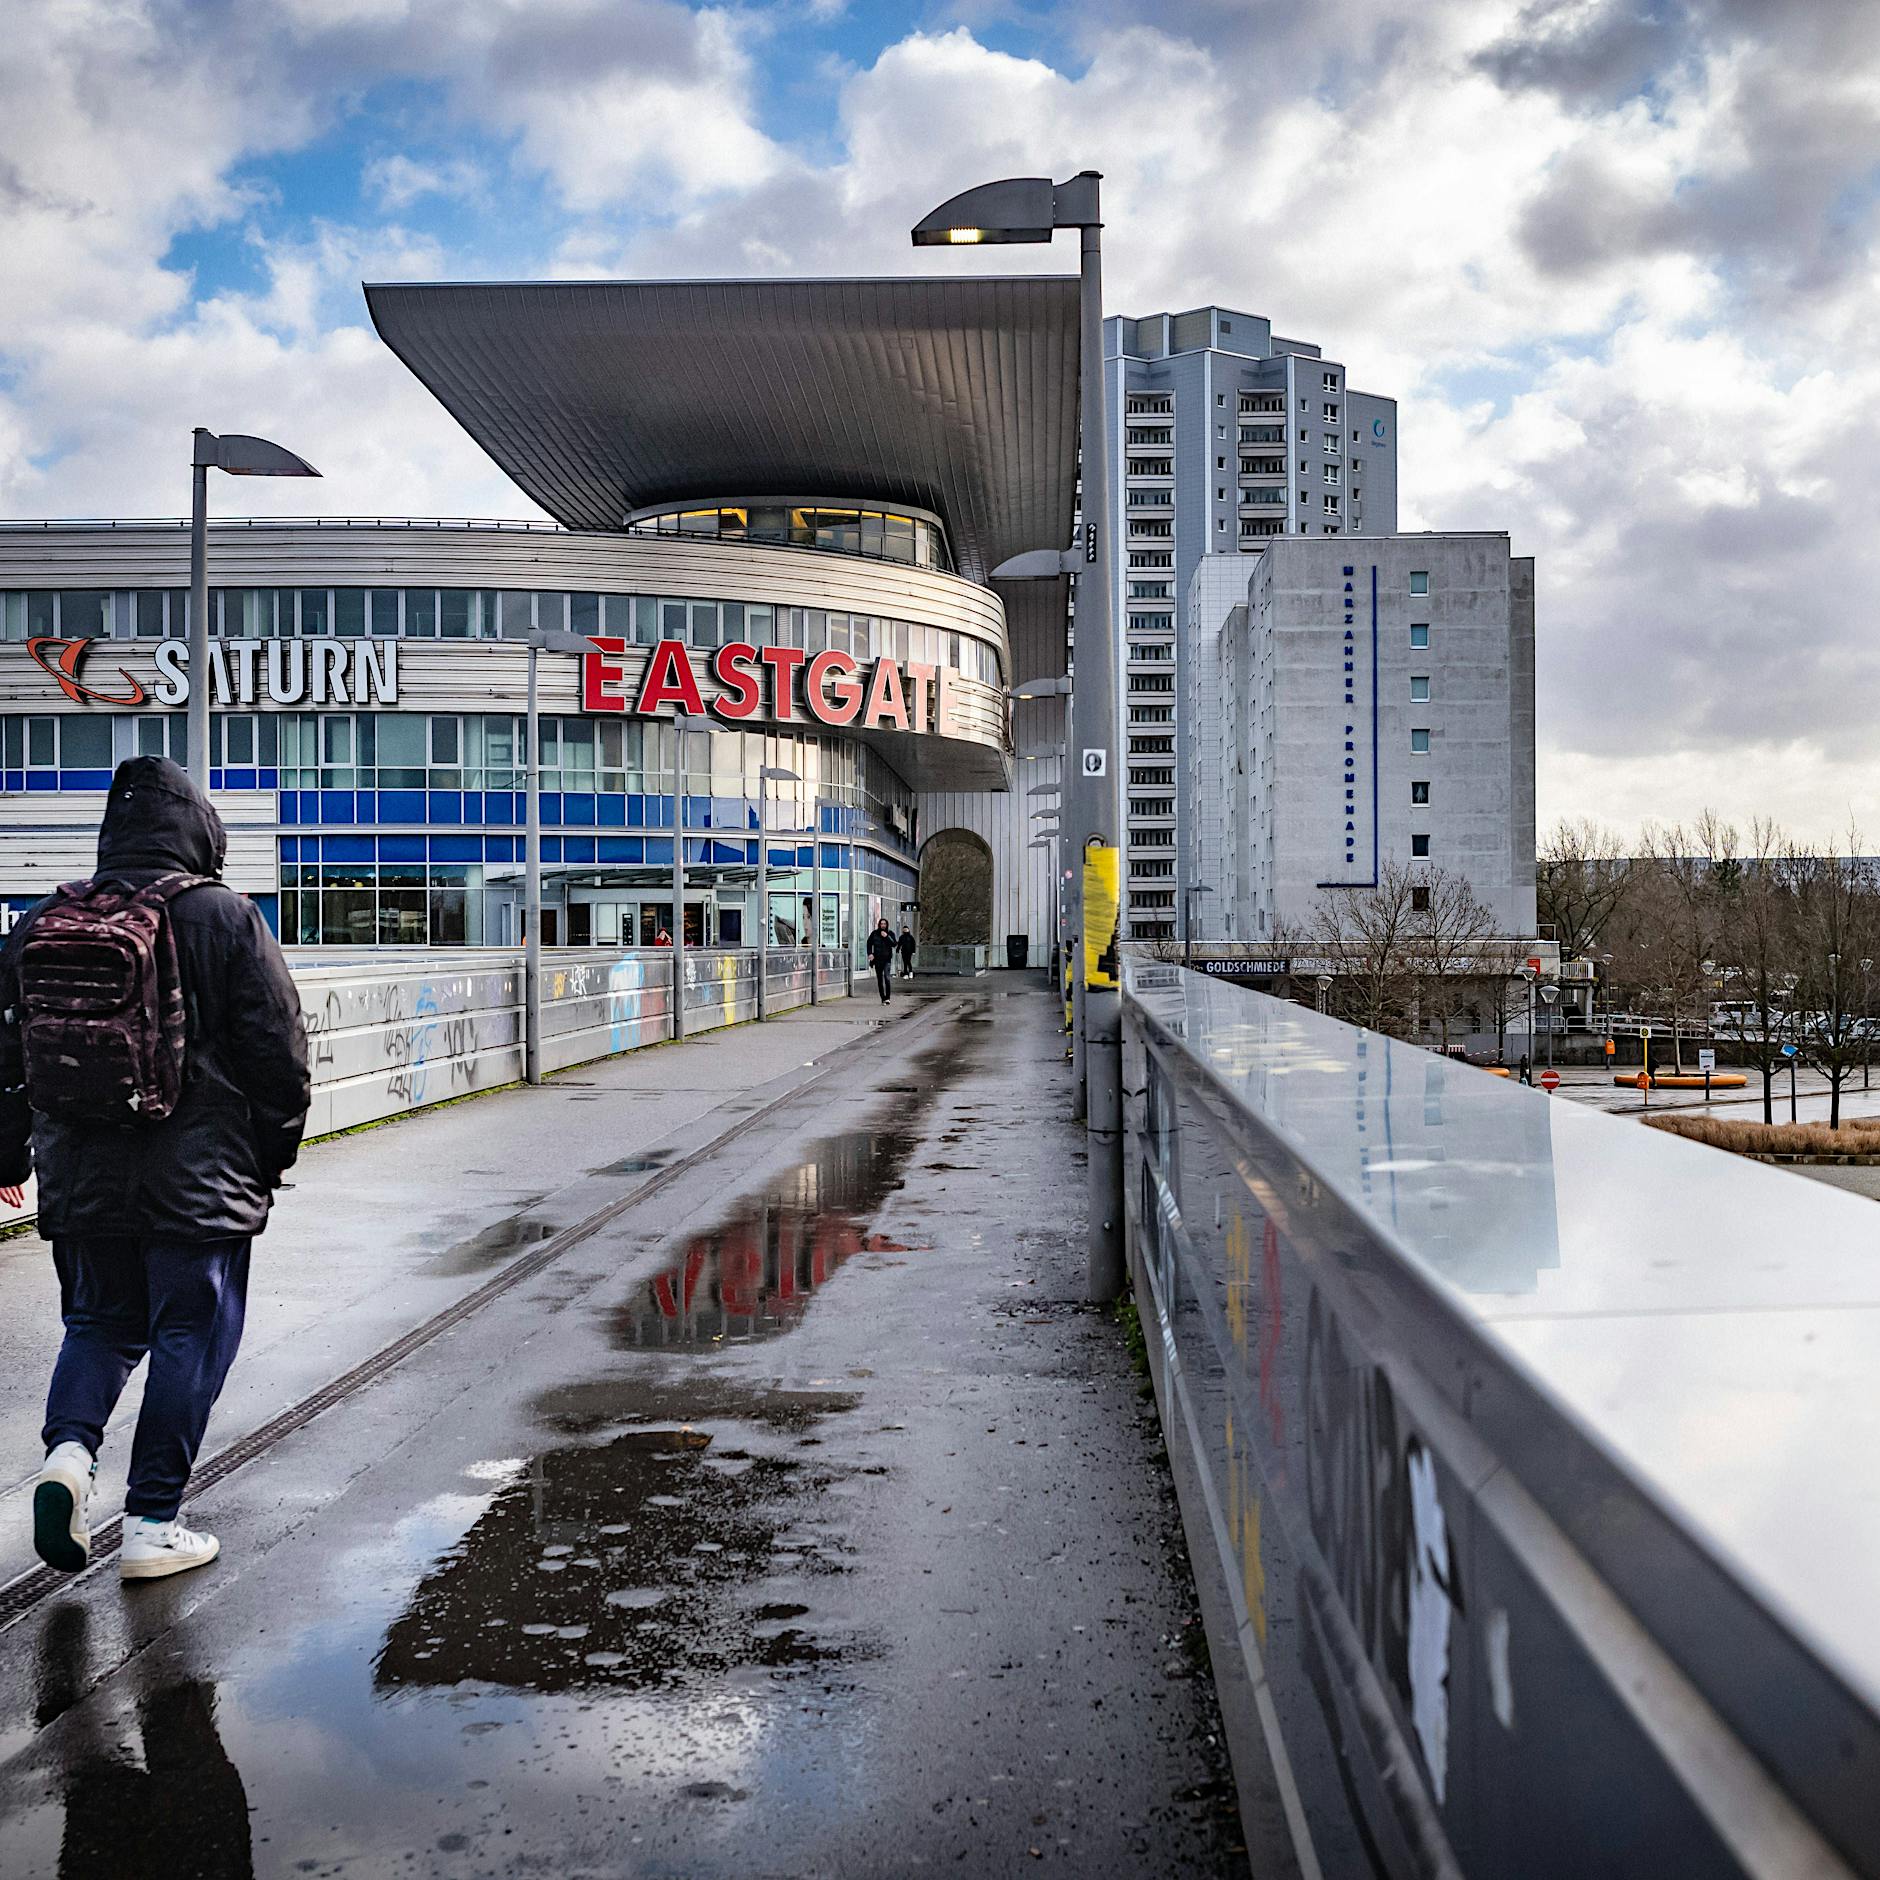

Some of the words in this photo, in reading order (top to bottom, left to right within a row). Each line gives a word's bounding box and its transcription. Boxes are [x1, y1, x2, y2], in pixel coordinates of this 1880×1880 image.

[153, 638, 399, 705] SATURN
[1343, 565, 1354, 704] MARZAHNER
[582, 636, 959, 733] EASTGATE
[1344, 725, 1355, 862] PROMENADE
[1206, 961, 1286, 974] GOLDSCHMIEDE
